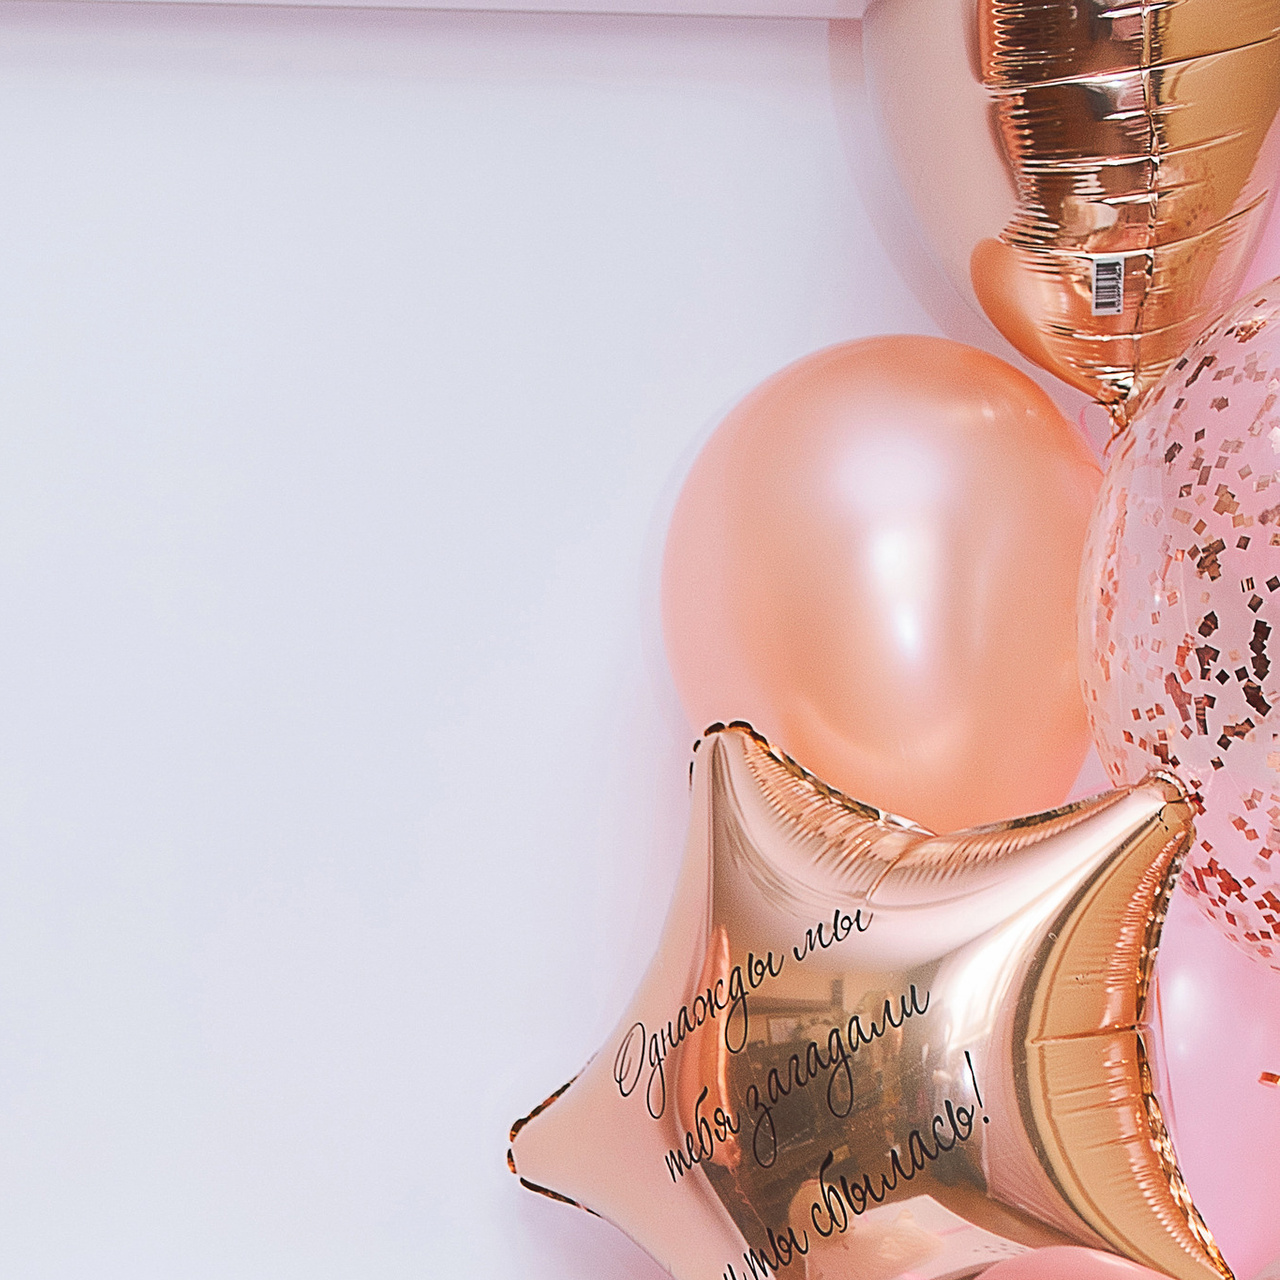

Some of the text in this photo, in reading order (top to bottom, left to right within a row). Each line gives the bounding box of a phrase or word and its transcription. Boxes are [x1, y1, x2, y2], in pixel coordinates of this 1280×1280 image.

[613, 908, 874, 1119] Однажды мы
[664, 983, 931, 1184] тебя загадали
[811, 1050, 991, 1238] сбылась!
